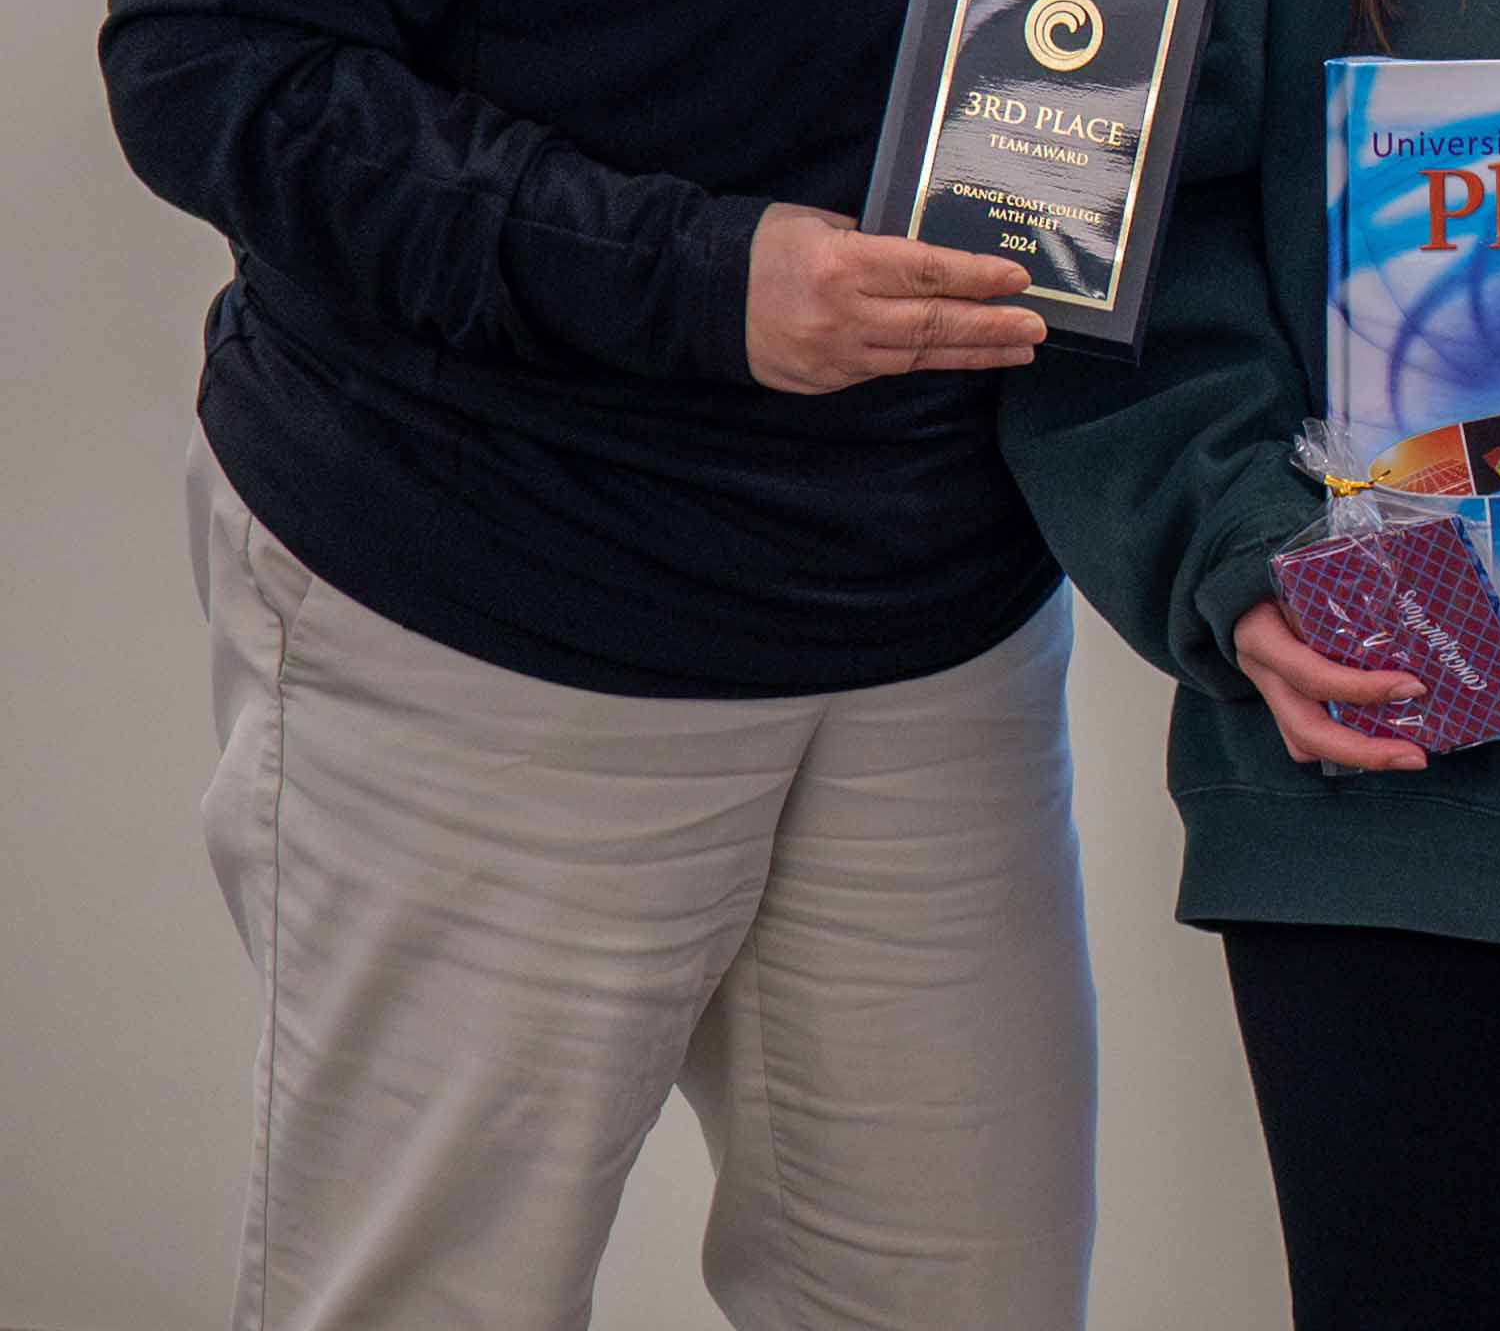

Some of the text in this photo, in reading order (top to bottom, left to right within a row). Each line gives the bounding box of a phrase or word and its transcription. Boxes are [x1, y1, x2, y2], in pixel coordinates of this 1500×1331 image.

[964, 91, 1126, 147] 3RD PLACE
[989, 134, 1089, 167] TEAM AWARD
[952, 183, 1102, 225] ORANGE COAST COLLEGE
[988, 207, 1061, 231] MATH MEET
[999, 232, 1039, 254] 2024
[1398, 589, 1488, 691] CONGRATULATIONS
